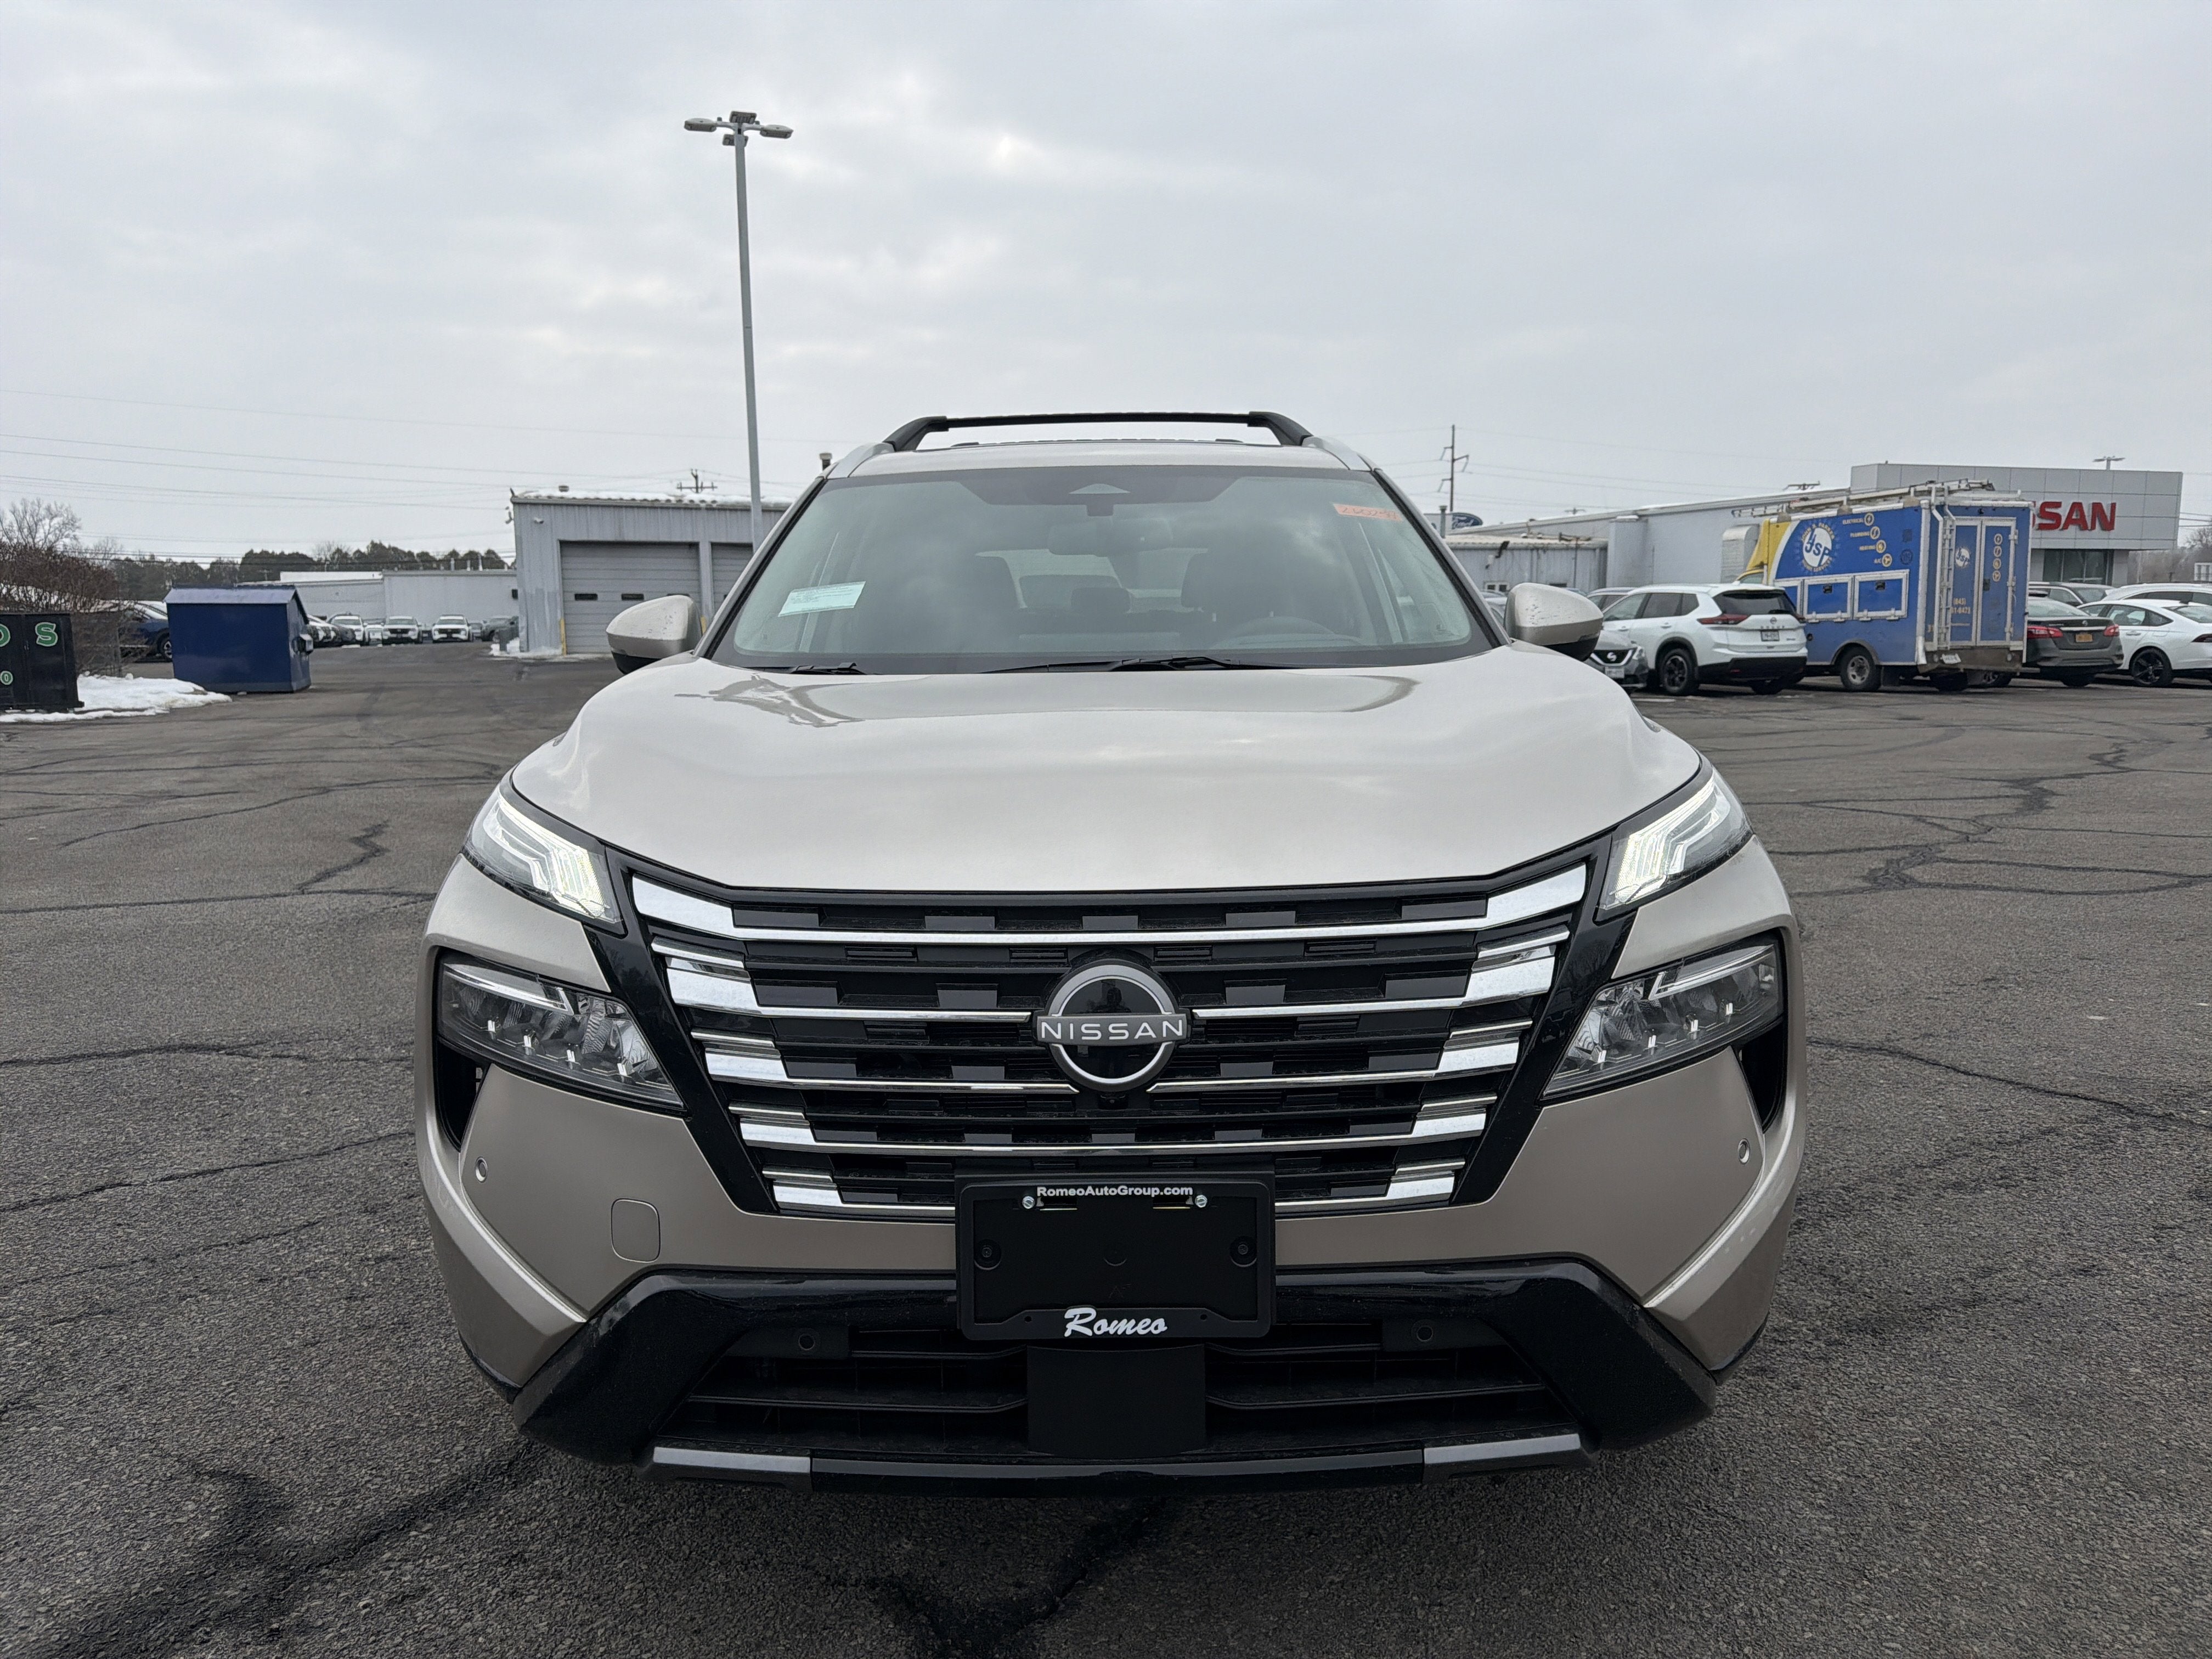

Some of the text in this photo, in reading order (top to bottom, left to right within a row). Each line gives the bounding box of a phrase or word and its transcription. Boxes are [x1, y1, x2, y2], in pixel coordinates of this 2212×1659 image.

[2033, 501, 2116, 531] SAN
[1041, 1019, 1183, 1040] NISSAN
[1037, 1186, 1193, 1198] RomeoAutoGroup.com
[1064, 1307, 1167, 1337] Romeo
